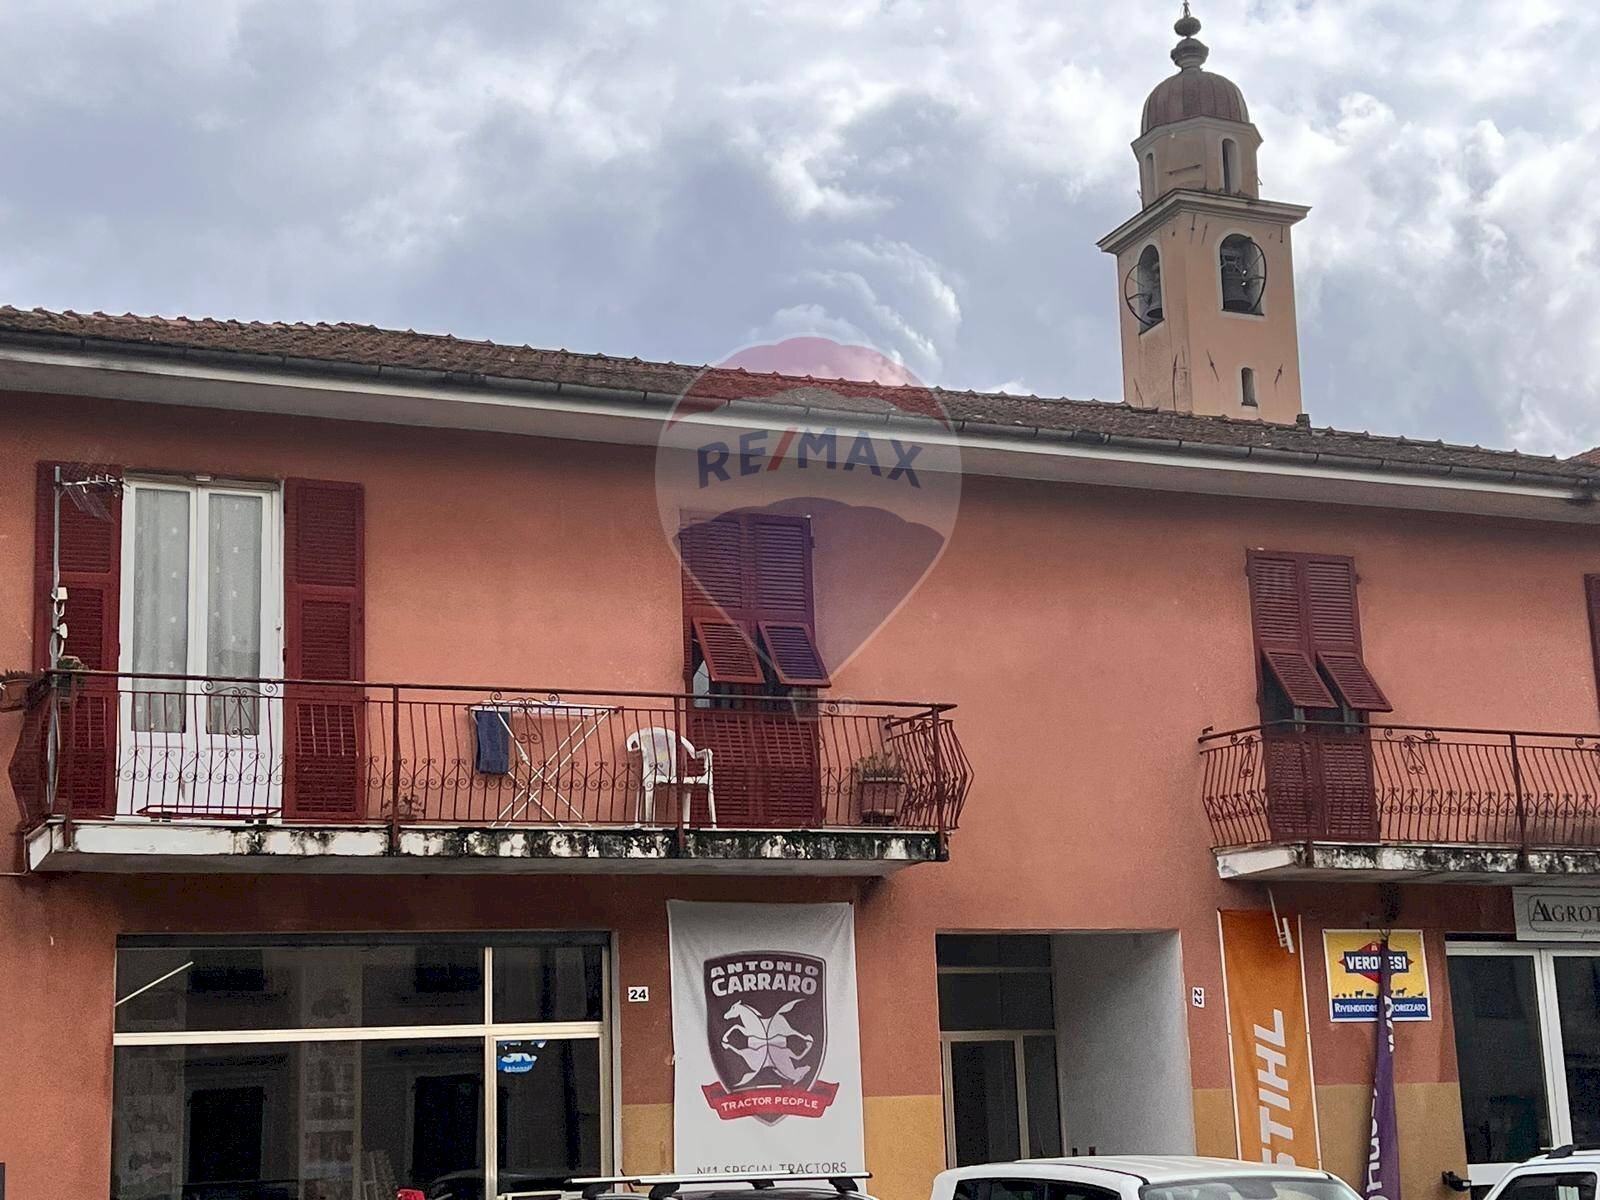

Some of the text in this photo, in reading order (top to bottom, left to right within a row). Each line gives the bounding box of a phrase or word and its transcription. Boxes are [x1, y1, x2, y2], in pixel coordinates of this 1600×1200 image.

[710, 960, 819, 978] ANTONIO
[1346, 956, 1407, 970] VEROESI
[711, 973, 817, 997] CARRARO
[630, 989, 647, 1000] 24
[1193, 988, 1203, 1005] 22
[721, 1097, 818, 1112] TRACTOR PEOPLE
[779, 1161, 847, 1174] TRACTORS
